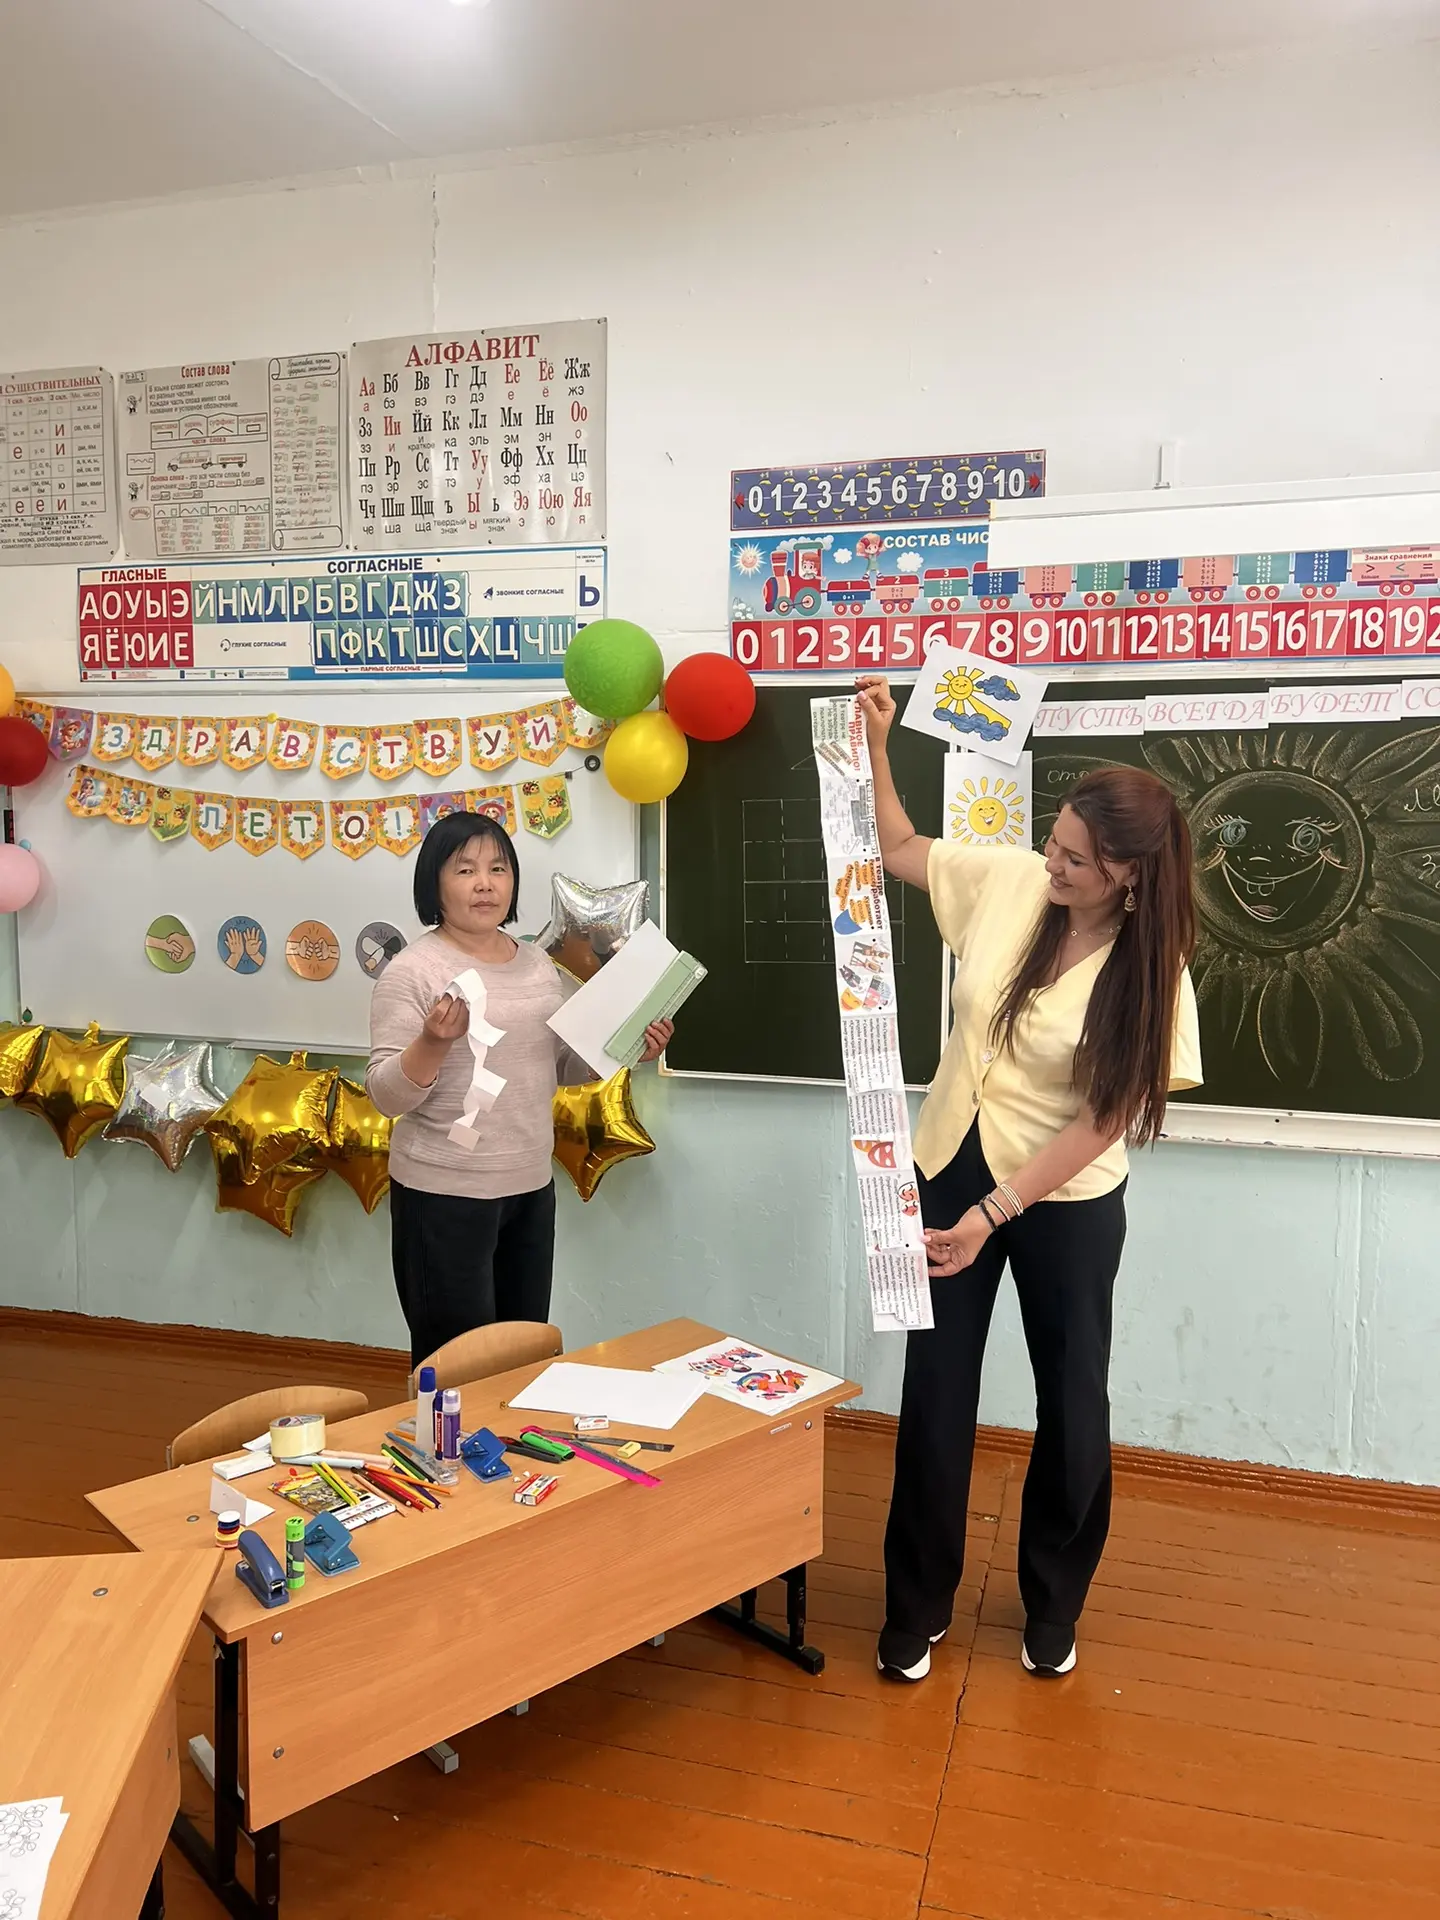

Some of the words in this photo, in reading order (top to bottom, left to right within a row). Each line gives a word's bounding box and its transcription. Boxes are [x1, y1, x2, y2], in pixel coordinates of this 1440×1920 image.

[405, 335, 540, 367] АЛФАВИТ
[5, 376, 101, 393] СУЩЕСТВИТЕЛЬНЫХ
[181, 366, 206, 379] Состав
[207, 363, 230, 376] слова
[359, 377, 375, 397] Аа
[383, 373, 399, 393] Бб
[414, 371, 430, 391] Вв
[445, 368, 459, 388] Гг
[469, 365, 487, 391] Дд
[505, 363, 520, 384] Ее
[538, 358, 554, 381] Ёё
[564, 357, 591, 380] Жж
[363, 402, 369, 412] а
[383, 397, 396, 409] бэ
[414, 397, 427, 407] вэ
[446, 395, 456, 404] гэ
[470, 392, 485, 404] дэ
[508, 391, 515, 400] е
[542, 386, 549, 398] ё
[568, 385, 585, 396] жэ
[359, 417, 372, 437] Зз
[384, 416, 401, 436] Ии
[412, 410, 432, 433] Йй
[442, 410, 460, 431] Кк
[469, 408, 487, 429] Лл
[500, 407, 523, 427] Мм
[535, 404, 554, 425] Нн
[571, 401, 587, 422] Оо
[360, 444, 371, 453] зэ
[445, 438, 457, 447] ка
[469, 436, 489, 446] эль
[504, 434, 519, 444] эм
[538, 432, 552, 442] эн
[359, 457, 376, 477] Пп
[385, 455, 400, 480] Рр
[416, 452, 430, 472] Сс
[443, 451, 459, 471] Тт
[472, 449, 488, 474] Уу
[500, 447, 523, 472] Фф
[536, 445, 554, 466] Хх
[568, 443, 587, 468] Цц
[361, 484, 373, 493] пэ
[387, 482, 399, 494] эр
[417, 480, 429, 490] эс
[445, 478, 456, 487] тэ
[477, 478, 482, 490] у
[503, 472, 520, 486] эф
[538, 473, 551, 483] ха
[571, 472, 585, 482] цэ
[748, 486, 763, 513] 0
[771, 484, 782, 511] 1
[792, 482, 808, 510] 2
[817, 481, 832, 509] 3
[841, 479, 857, 506] 4
[867, 477, 882, 505] 5
[891, 475, 908, 504] 6
[916, 474, 932, 502] 7
[941, 472, 957, 501] 8
[967, 470, 984, 500] 9
[993, 468, 1026, 497] 10
[359, 499, 375, 519] Чч
[381, 498, 405, 518] Шш
[411, 495, 435, 519] Щщ
[514, 490, 529, 510] Ээ
[538, 488, 563, 510] Юю
[573, 486, 592, 507] Яя
[363, 525, 374, 535] че
[385, 524, 401, 534] ша
[884, 533, 950, 549] СОСТАВ
[327, 558, 423, 574] СОГЛАСНЫЕ
[1389, 553, 1433, 561] сравнения
[101, 568, 167, 582] ГЛАСНЫЕ
[736, 629, 759, 665] 0
[771, 628, 785, 663] 1
[797, 626, 819, 663] 2
[827, 625, 850, 662] 3
[858, 624, 884, 661] 4
[892, 623, 915, 660] 5
[923, 621, 948, 655] 6
[956, 621, 981, 650] 7
[988, 618, 1015, 658] 8
[1023, 618, 1049, 657] 9
[1055, 617, 1087, 656] 10
[1091, 616, 1121, 655] 11
[1126, 614, 1158, 654] 12
[1162, 612, 1194, 654] 13
[1198, 612, 1231, 653] 14
[1235, 610, 1270, 651] 15
[1273, 609, 1307, 650] 16
[1311, 609, 1346, 649] 17
[1350, 606, 1384, 648] 18
[1389, 605, 1425, 647] 19
[854, 701, 864, 747] ГЛАВНОЕ
[1035, 706, 1144, 730] ПУСТЬ
[1147, 698, 1269, 726] ВСЕГДА
[1270, 687, 1395, 718] БУДЕТ
[849, 721, 860, 771] ПРАВИЛО!
[202, 806, 402, 839] ЛЕТО!
[871, 888, 883, 929] работает
